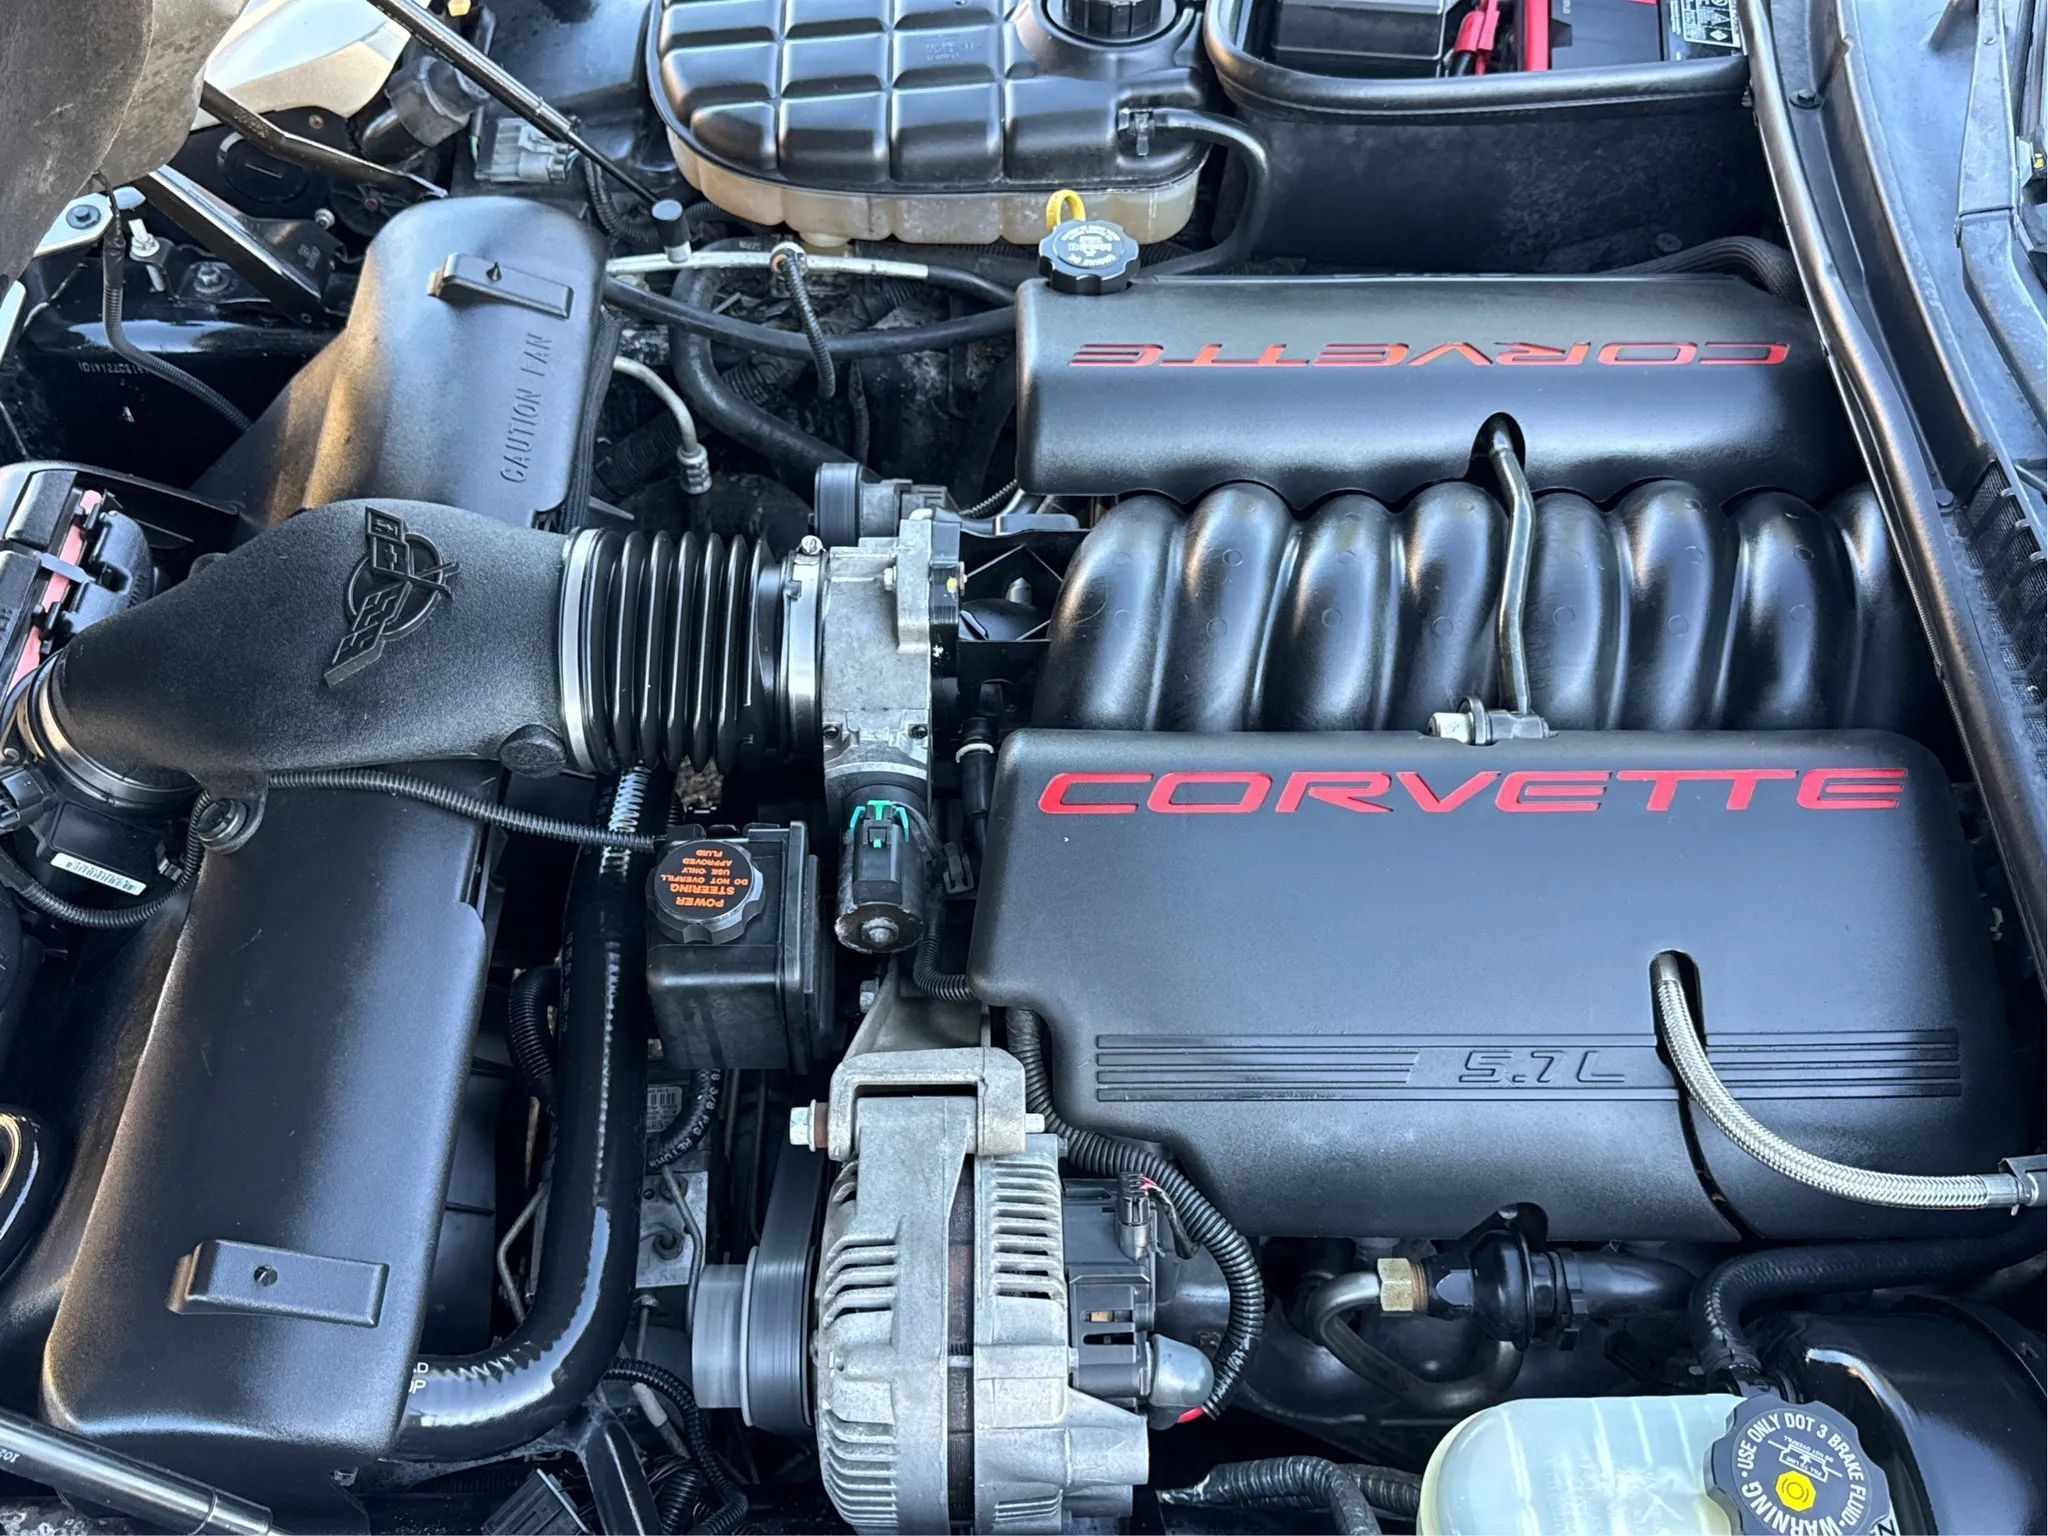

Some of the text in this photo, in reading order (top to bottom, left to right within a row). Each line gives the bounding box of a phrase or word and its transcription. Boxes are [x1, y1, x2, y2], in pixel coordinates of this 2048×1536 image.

[1069, 341, 1792, 368] CORVETTE
[500, 332, 552, 484] CAUTION FAN
[1038, 767, 1909, 815] CORVETTE
[682, 857, 733, 867] APPROVED
[695, 849, 724, 857] FLUID
[660, 874, 749, 886] DO NOT OVERFILL
[711, 868, 731, 876] USE
[670, 883, 735, 896] STEERING
[676, 896, 725, 908] POWER
[1458, 1049, 1625, 1083] 5.7L
[1736, 1412, 1866, 1526] USE ONLY DOT 3 BRAKE FLUID
[1741, 1480, 1844, 1536] WARNING
